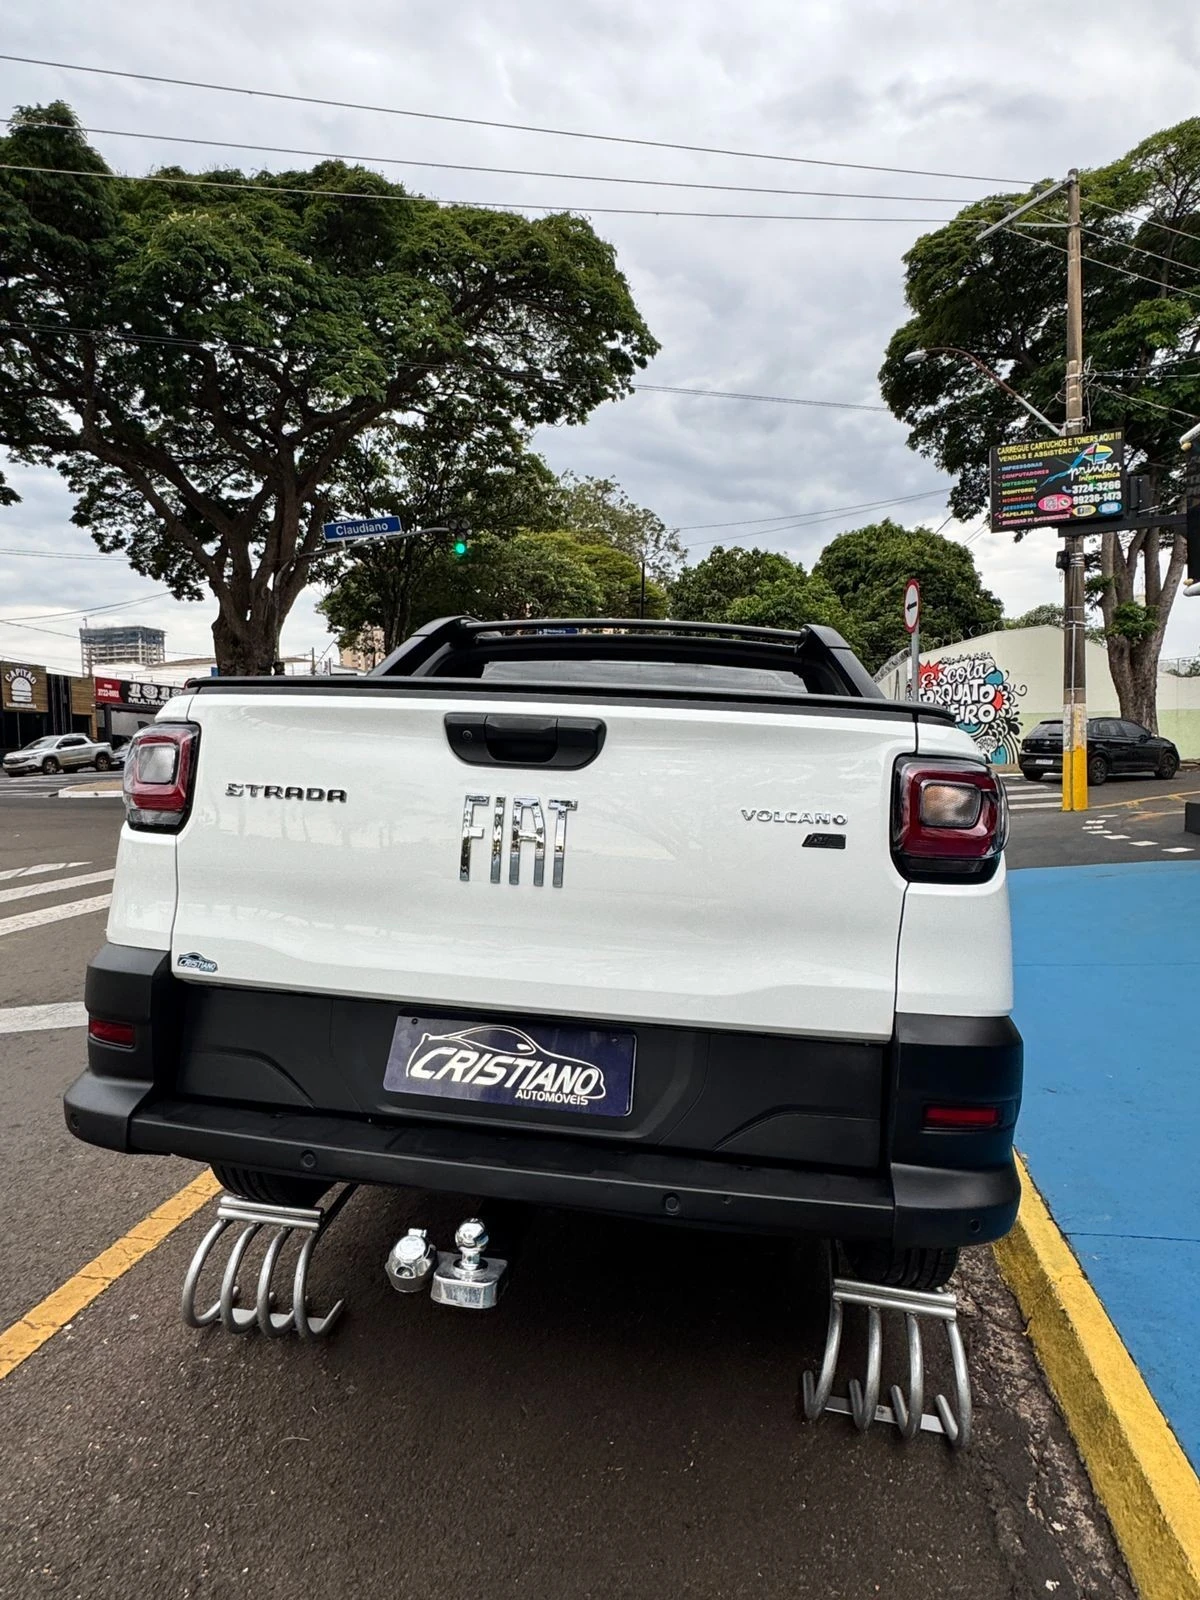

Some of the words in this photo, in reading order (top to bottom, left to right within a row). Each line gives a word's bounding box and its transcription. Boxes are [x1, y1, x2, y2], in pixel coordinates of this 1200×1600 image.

[997, 444, 1029, 455] CARREGUE
[1030, 440, 1066, 451] CARTUCHOS
[1074, 435, 1097, 445] TONERS
[1098, 433, 1114, 442] AQUI
[998, 454, 1027, 462] VENDAS
[1002, 469, 1049, 479] COMPUTADORES
[1002, 479, 1037, 487] NOTEBOOKS
[1072, 480, 1121, 494] 3724-3266
[1002, 487, 1036, 495] MONITORES
[1073, 491, 1122, 505] 99236-1473
[1002, 510, 1034, 518] PAPELARIA
[336, 523, 388, 536] Claudiano
[921, 660, 994, 689] Escola
[128, 697, 166, 706] MULTIMA
[949, 704, 996, 725] EIRO
[225, 783, 347, 803] STRADA
[741, 809, 848, 825] VOLCANO
[459, 794, 578, 888] FIAT
[179, 958, 216, 971] CRISTIANO
[409, 1046, 600, 1095] CRISTIANO
[515, 1089, 589, 1106] AUTOMÓVEIS
